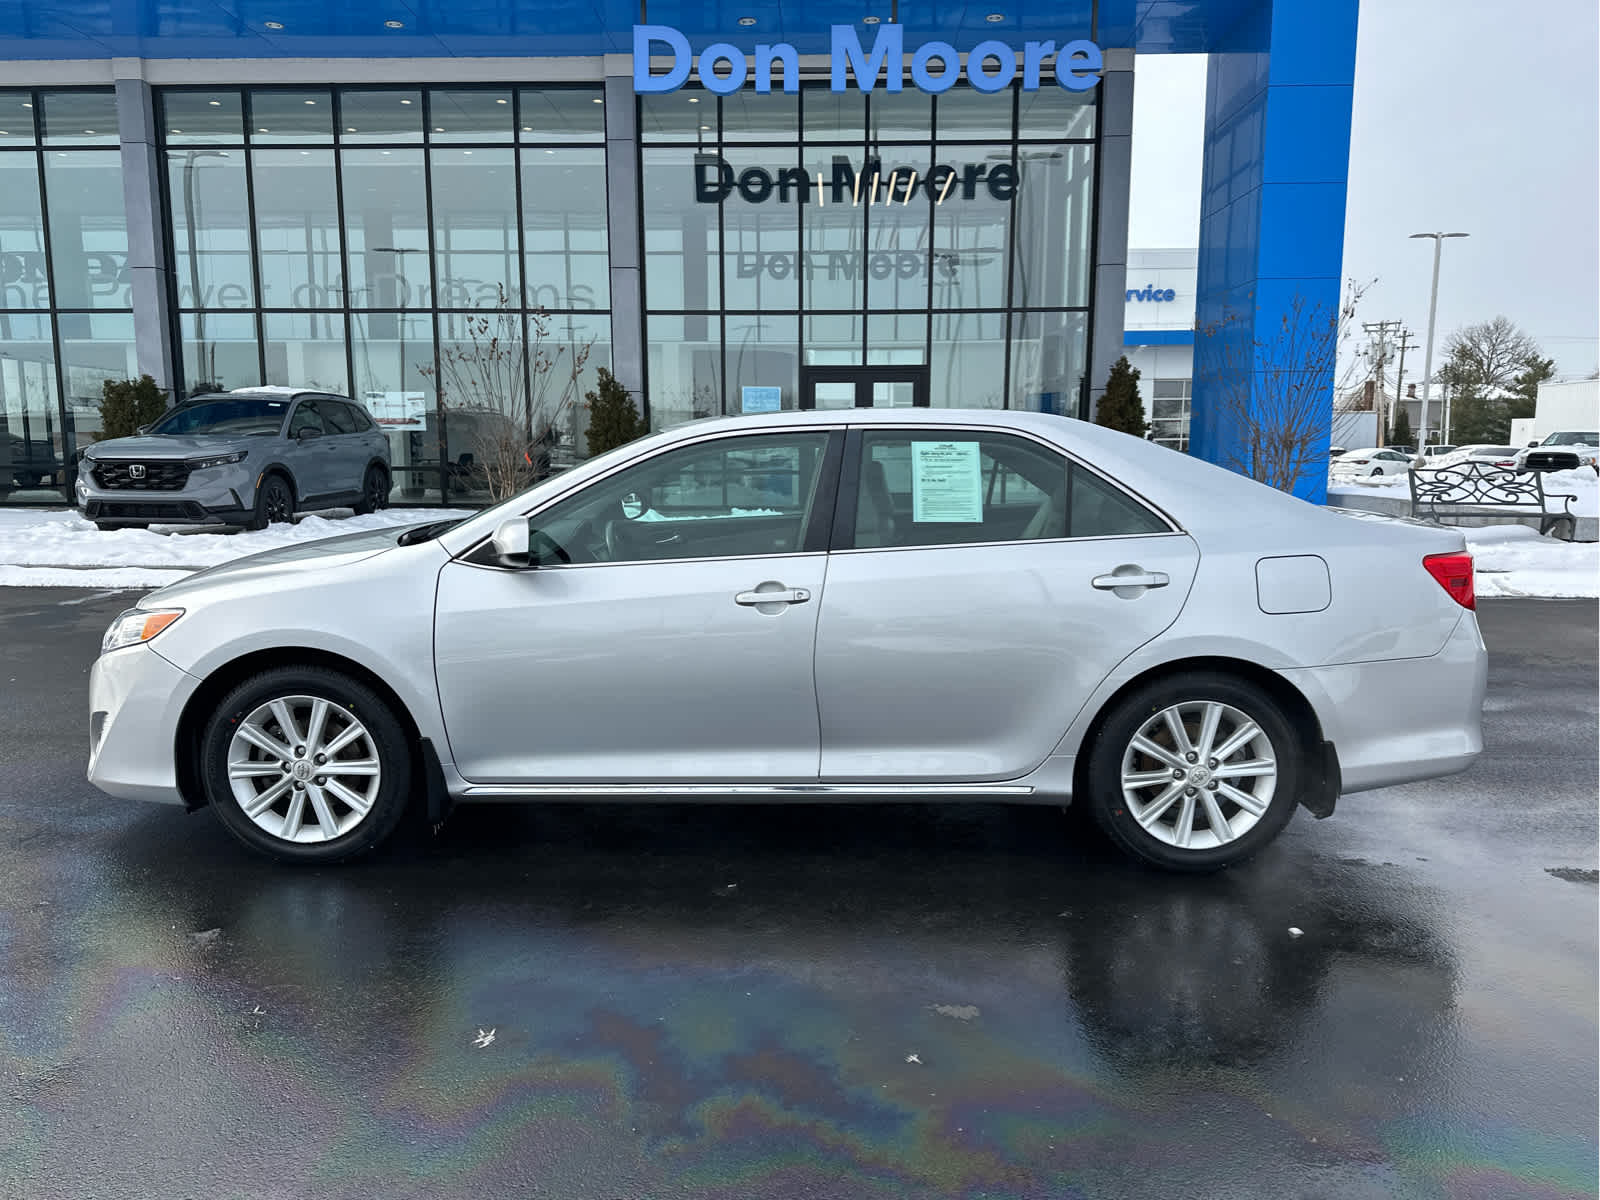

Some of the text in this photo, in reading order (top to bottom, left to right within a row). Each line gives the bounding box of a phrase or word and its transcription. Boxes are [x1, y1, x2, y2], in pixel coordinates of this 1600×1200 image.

[633, 24, 1103, 96] Don Moore
[694, 153, 1019, 203] Don Moore
[88, 272, 272, 313] Pwer
[1126, 284, 1175, 302] rvice
